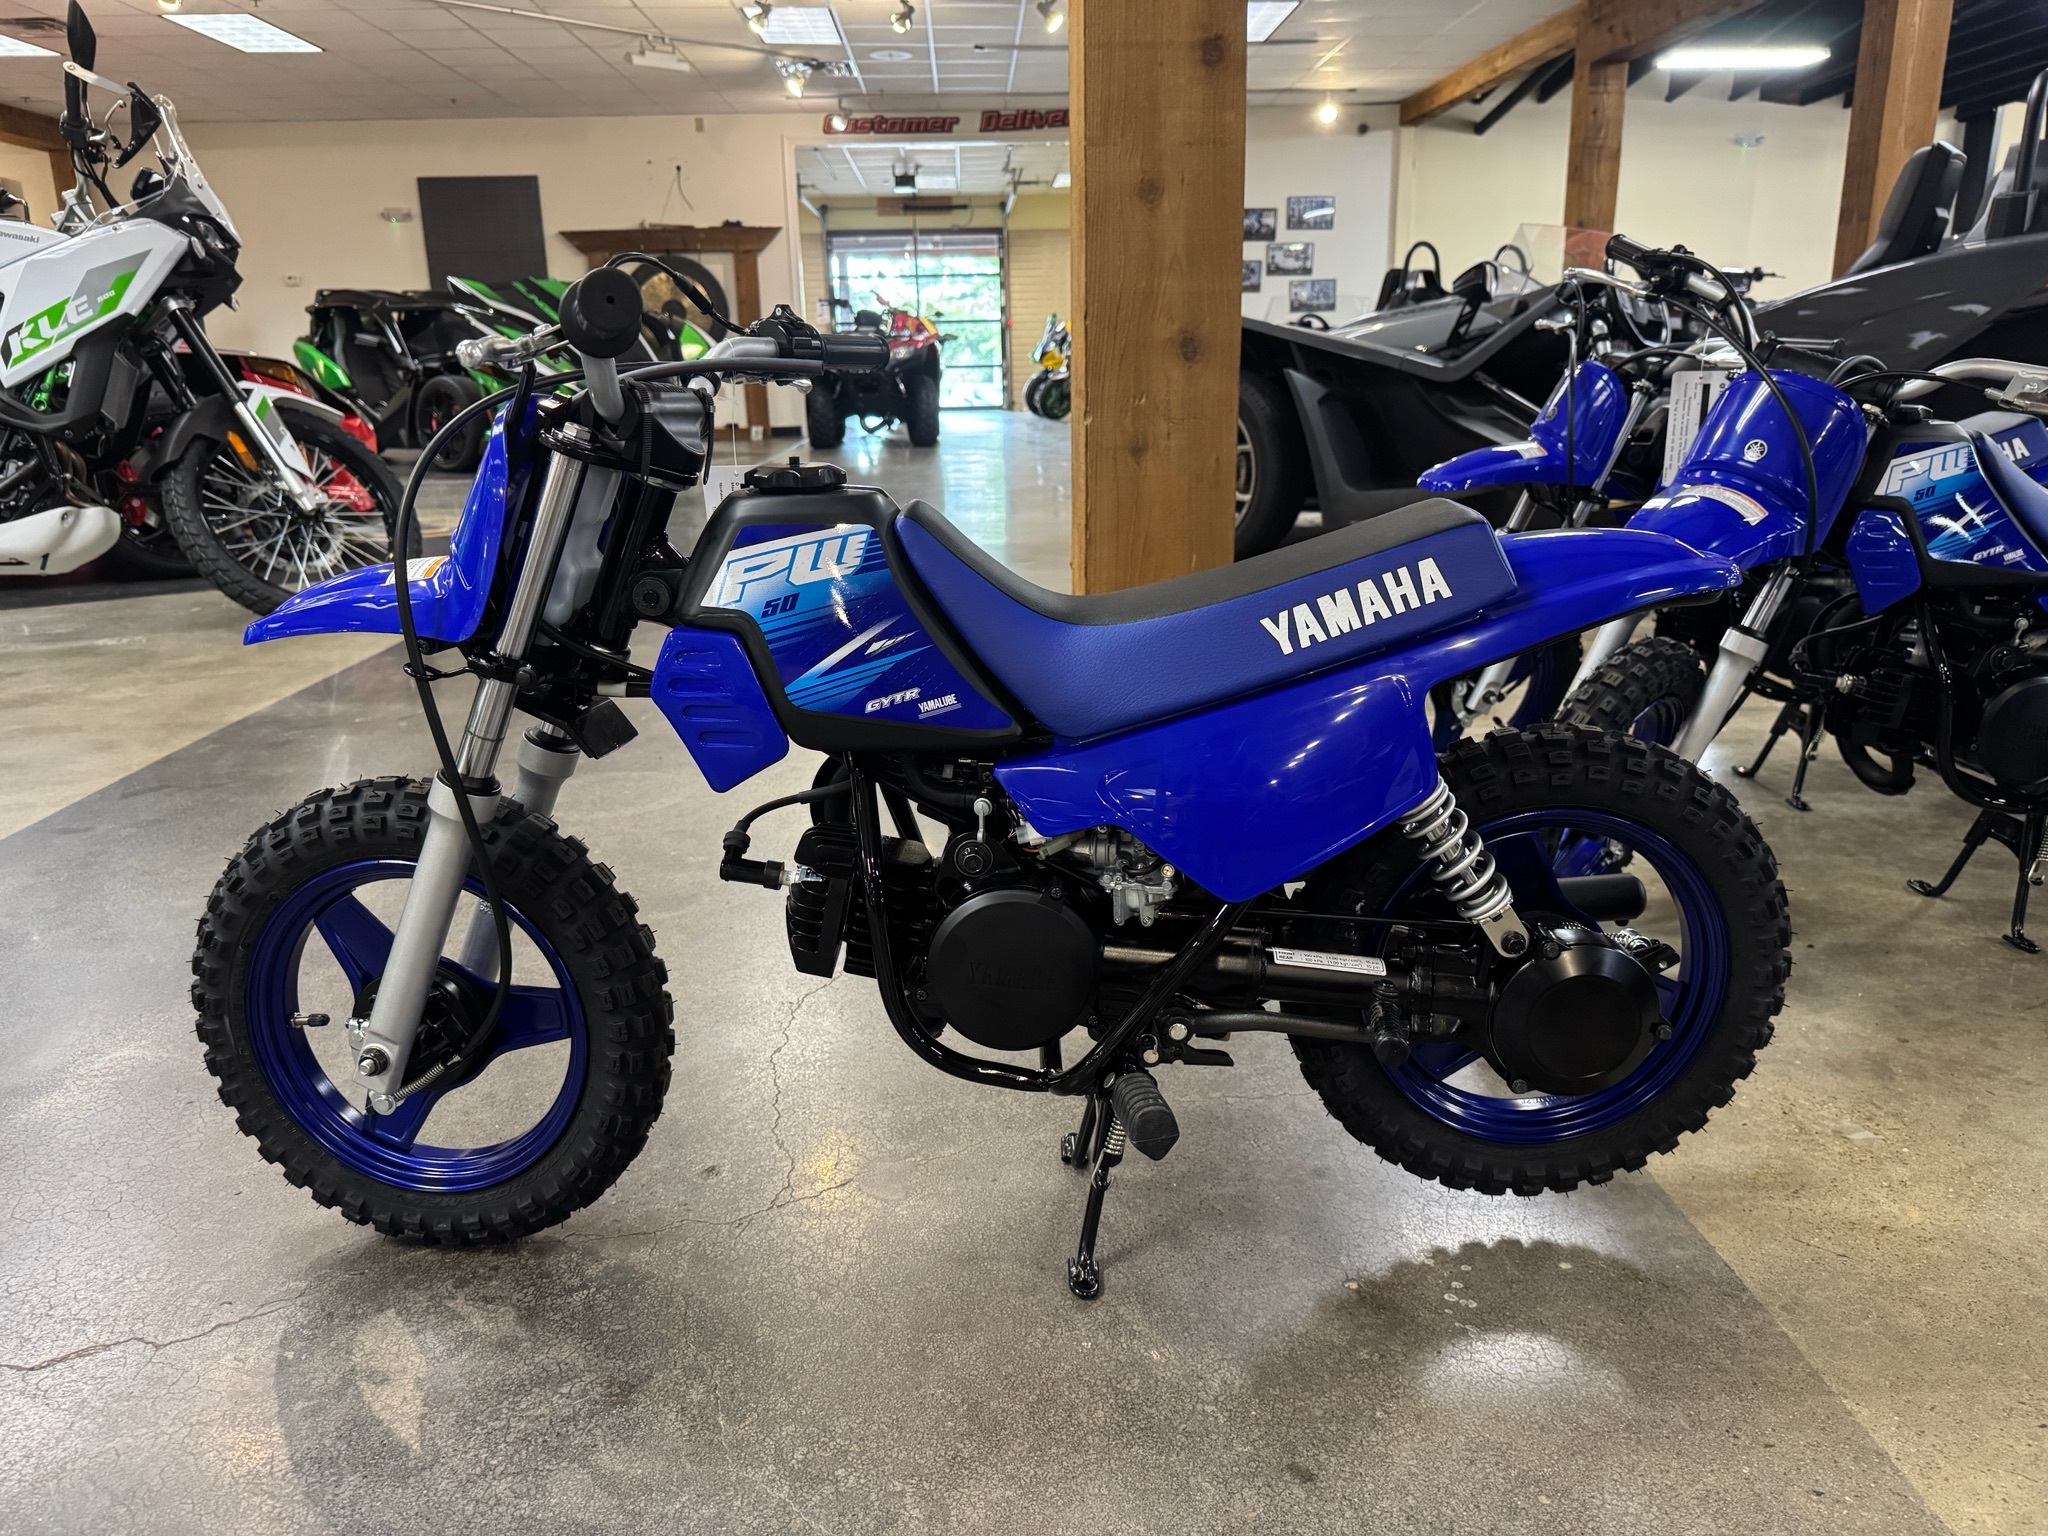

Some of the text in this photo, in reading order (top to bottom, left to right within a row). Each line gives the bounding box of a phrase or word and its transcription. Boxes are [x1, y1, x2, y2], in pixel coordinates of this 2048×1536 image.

[979, 109, 1069, 132] Delive
[0, 231, 40, 243] awasaki
[8, 289, 115, 358] KLE 500
[1886, 445, 1971, 496] PW
[1914, 485, 1936, 501] 50
[1973, 545, 2005, 561] GYTR
[717, 530, 872, 606] PW
[760, 592, 800, 618] 50
[1259, 557, 1453, 655] YAMAHA
[865, 686, 921, 713] GYTR
[918, 694, 957, 713] YAMALUBE
